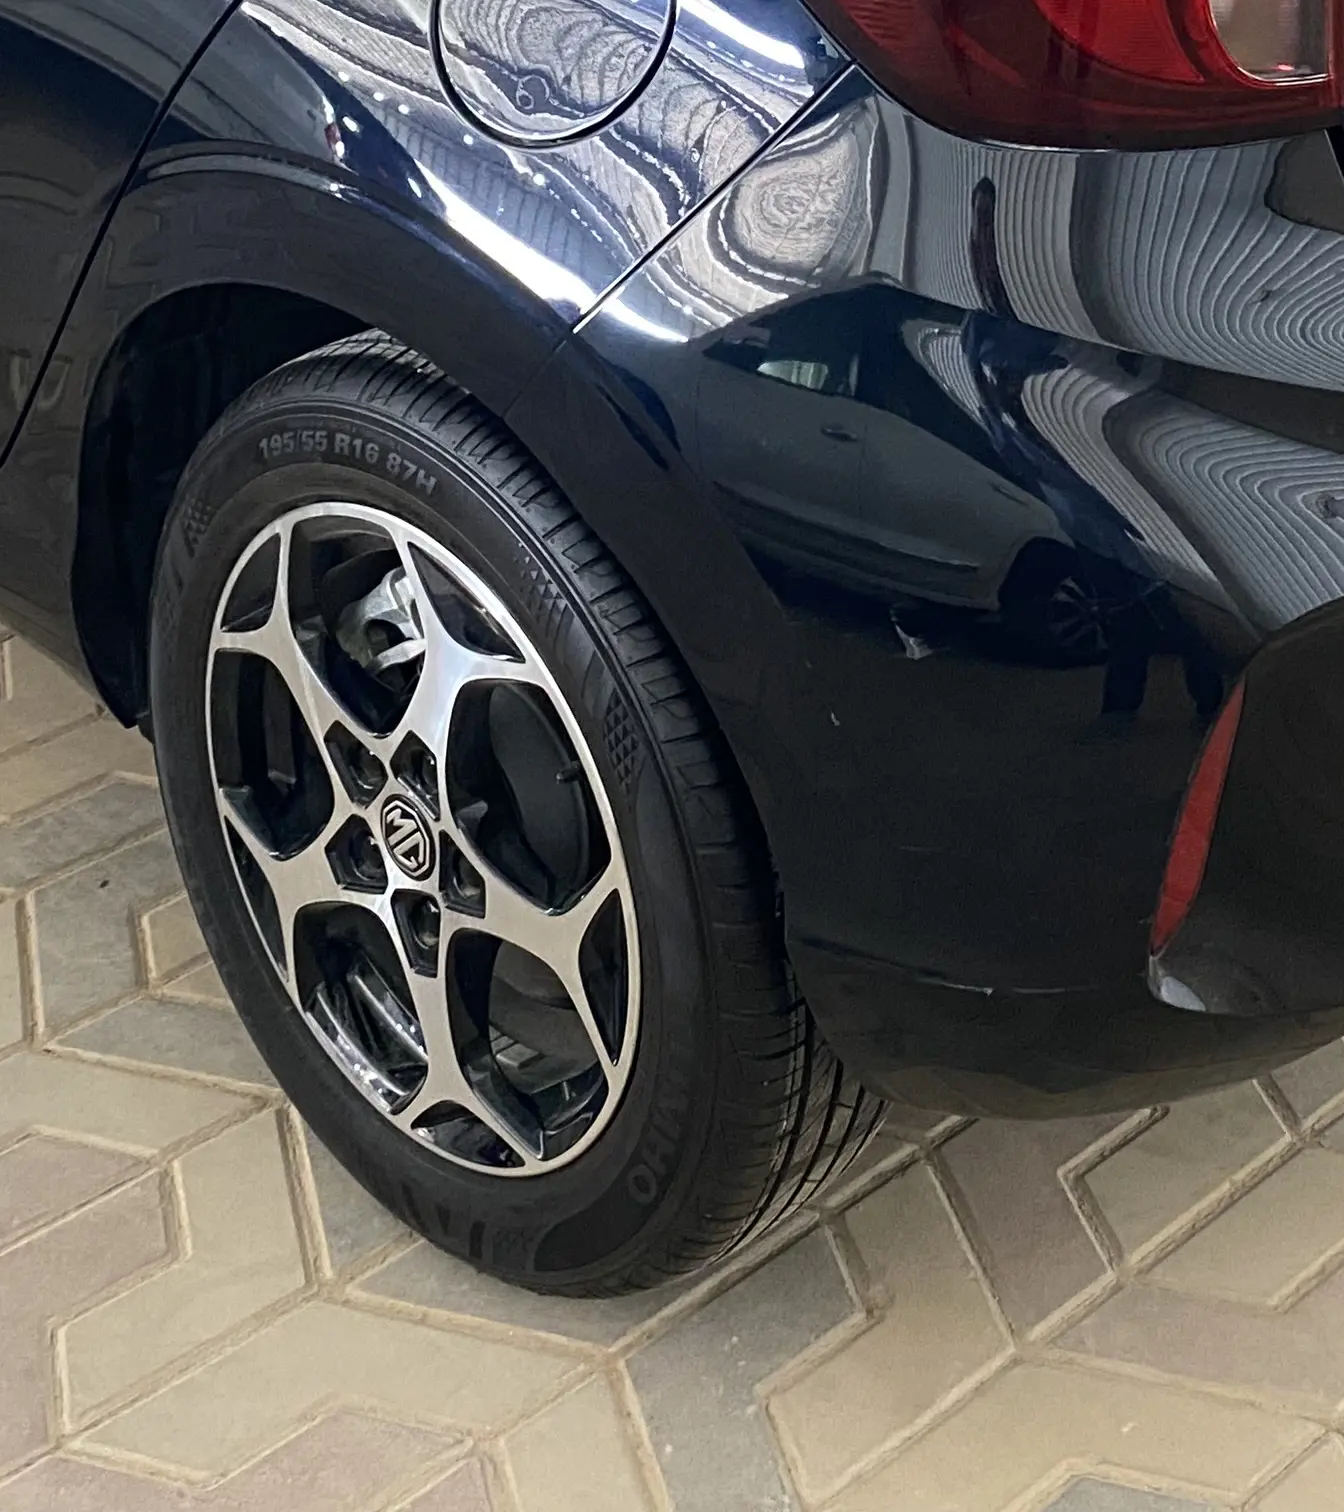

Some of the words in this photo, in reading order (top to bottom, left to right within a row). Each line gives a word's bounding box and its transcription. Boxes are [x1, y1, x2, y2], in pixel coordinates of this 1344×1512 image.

[259, 430, 328, 459] 195/55
[334, 433, 380, 464] R16
[386, 452, 437, 497] 87H
[386, 807, 425, 870] MG
